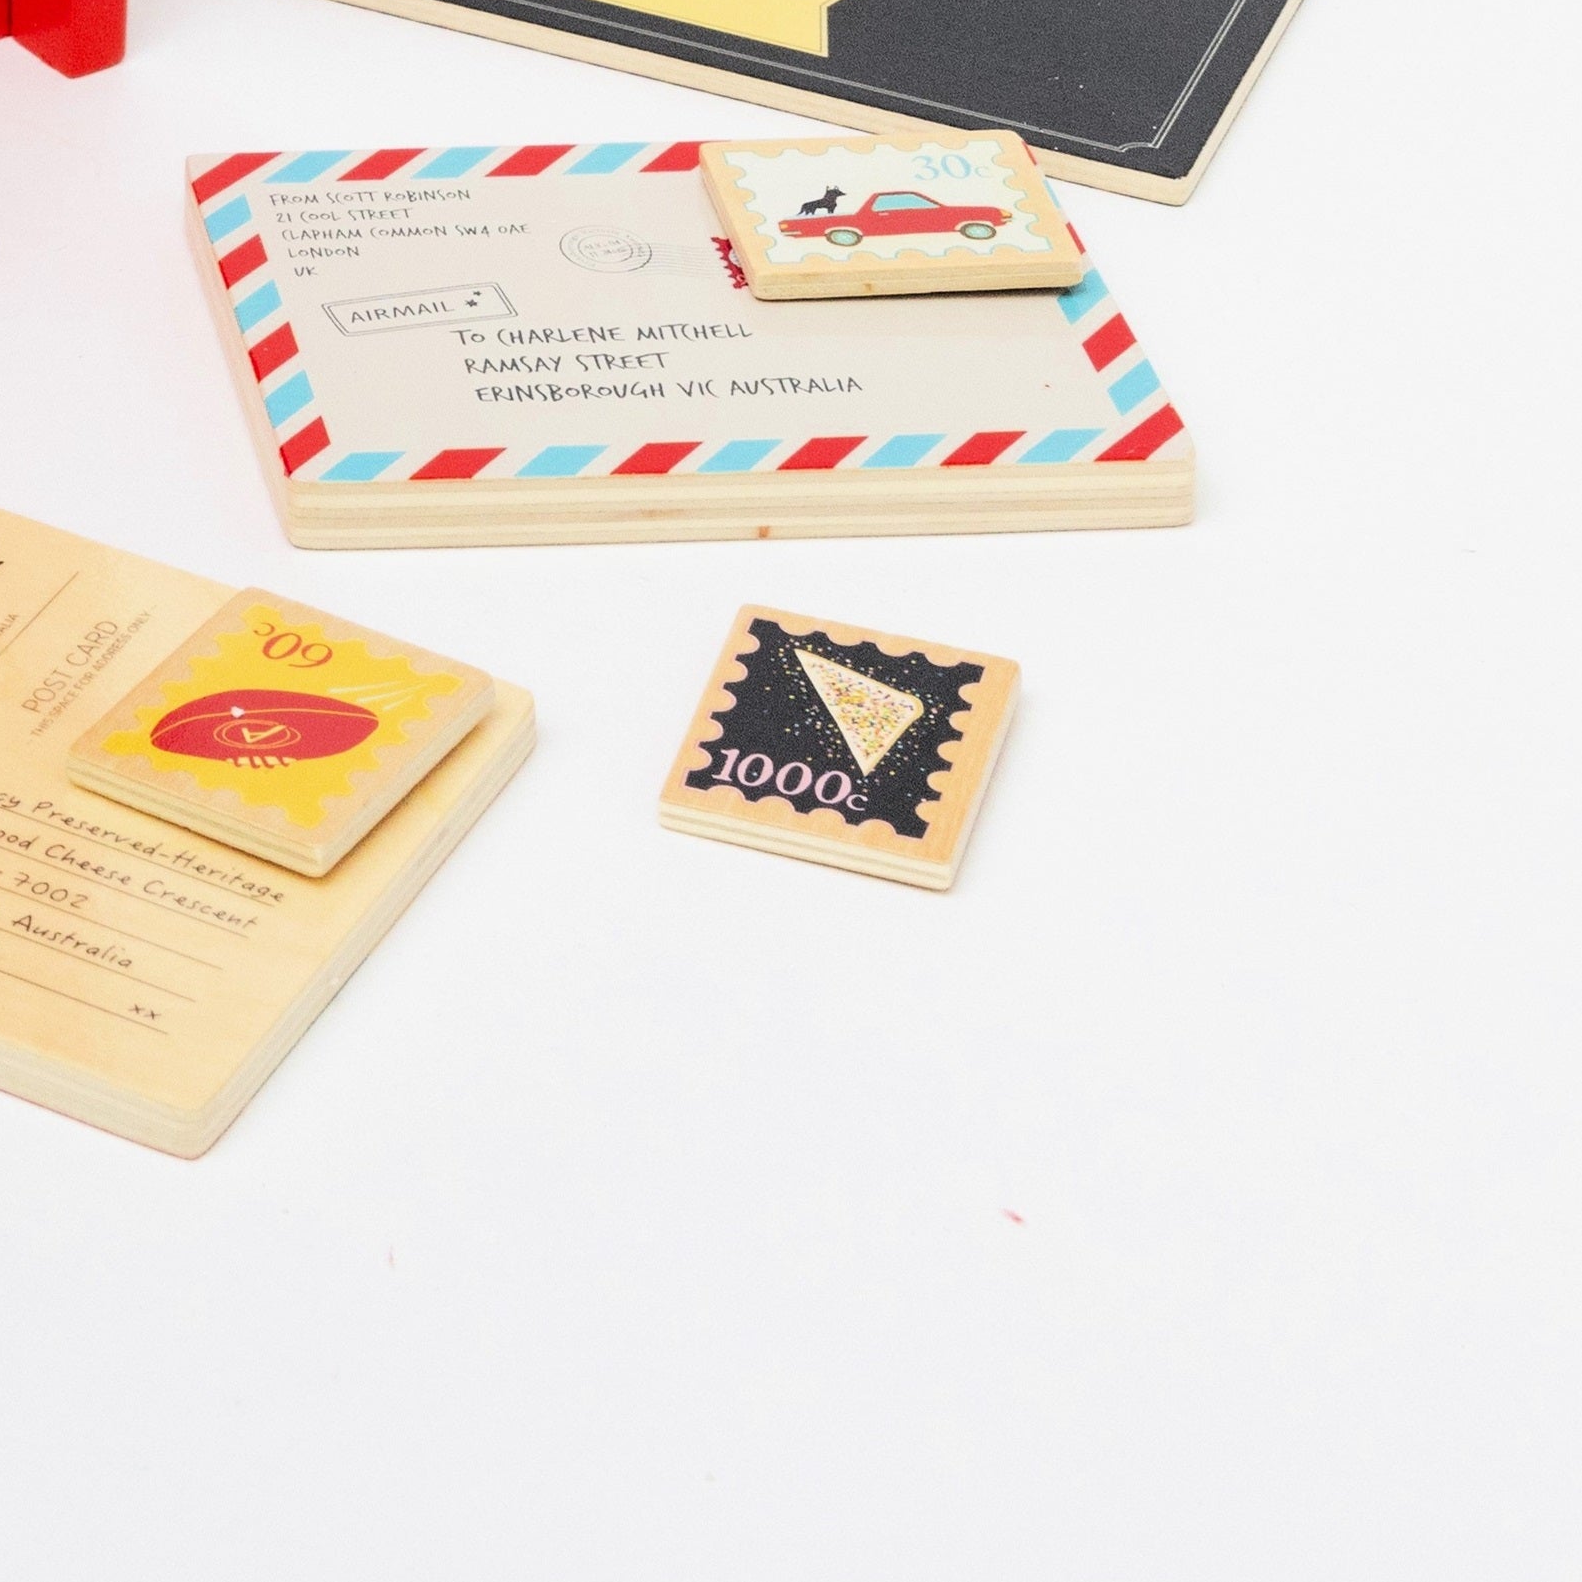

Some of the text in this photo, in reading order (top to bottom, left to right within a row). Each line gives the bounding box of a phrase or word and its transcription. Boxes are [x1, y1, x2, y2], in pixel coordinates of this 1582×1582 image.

[911, 154, 990, 181] 30c
[269, 189, 472, 206] FROM SCOTT ROBINSON
[276, 208, 413, 222] 21 COOL STREET
[281, 227, 363, 240] CLAPHAM
[369, 226, 447, 237] COMMON
[454, 224, 490, 236] SW4
[288, 246, 360, 259] LONDON
[294, 266, 318, 277] UK
[350, 299, 455, 324] AIRMAIL
[449, 322, 754, 346] TO CHARLENE MITCHELL
[465, 351, 671, 375] RAMSAY STREET
[476, 375, 863, 404] ERINSBOROUGH VIC AUSTRALIA
[21, 620, 119, 713] POST CARD
[712, 748, 869, 812] 1000c
[32, 792, 284, 904] Preserved-Heritage
[14, 871, 95, 909] 7002
[44, 843, 132, 886] Cheese
[142, 879, 259, 929] Crescent
[12, 915, 133, 969] Australia
